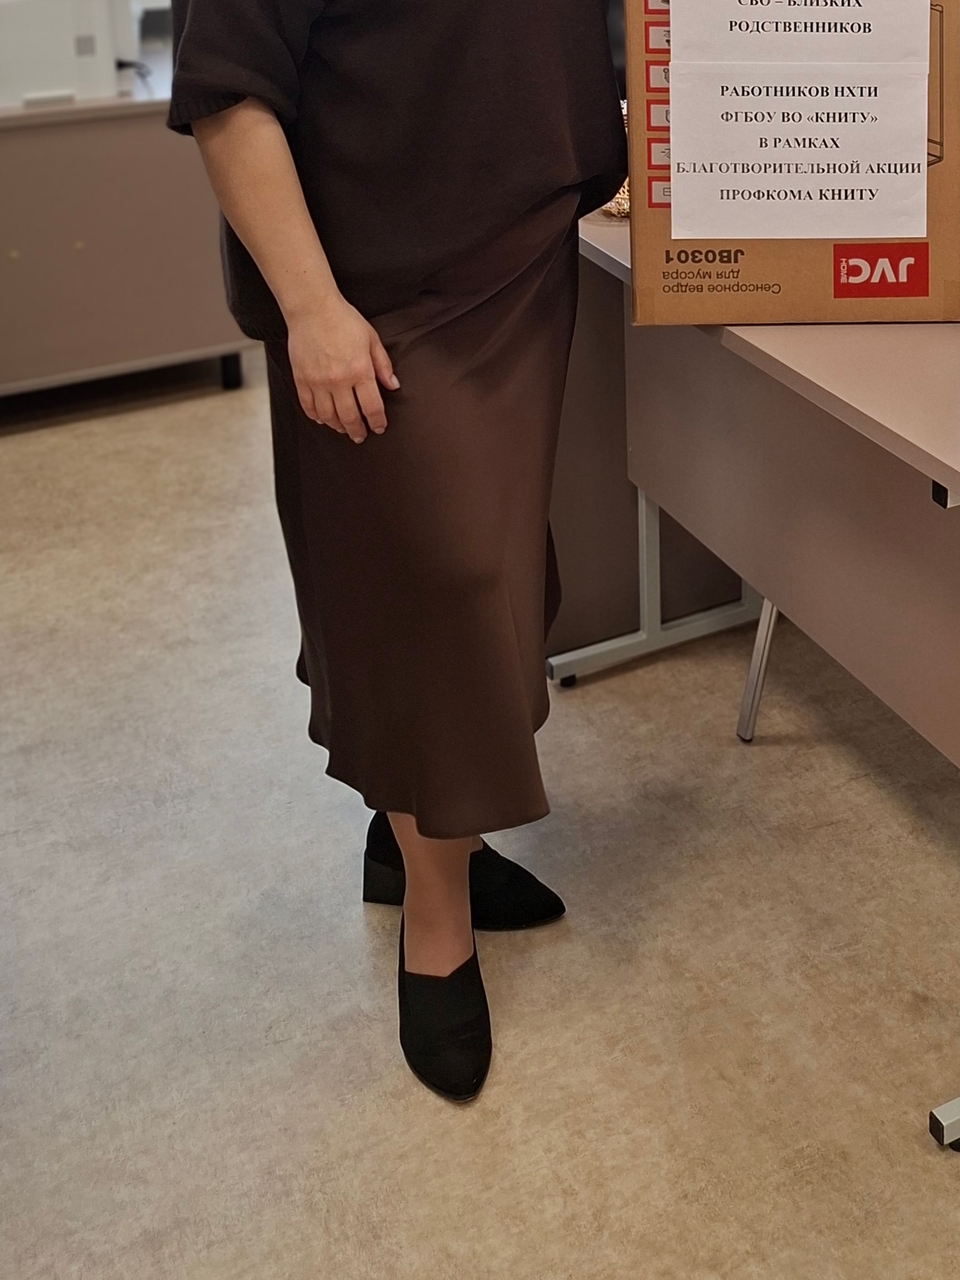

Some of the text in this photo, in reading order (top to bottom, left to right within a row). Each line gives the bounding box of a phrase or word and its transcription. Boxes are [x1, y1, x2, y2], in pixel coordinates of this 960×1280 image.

[728, 20, 872, 35] РОДСТВЕННИКОВ
[719, 84, 879, 98] РАБОТНИКОВ НХТИ
[720, 110, 879, 125] ФГБОУ ВО «КНИТУ»
[758, 136, 840, 150] В РАМКАХ
[676, 158, 922, 177] БЛАГОТВОРИТЕЛЬНОЙ АКЦИИ
[719, 187, 880, 201] ПРОФКОМА КНИТУ
[665, 249, 744, 264] JB0301
[662, 270, 740, 280] для мусора
[840, 258, 848, 284] HOME
[848, 257, 915, 284] JVC
[662, 283, 781, 295] Сенсорное ведро
